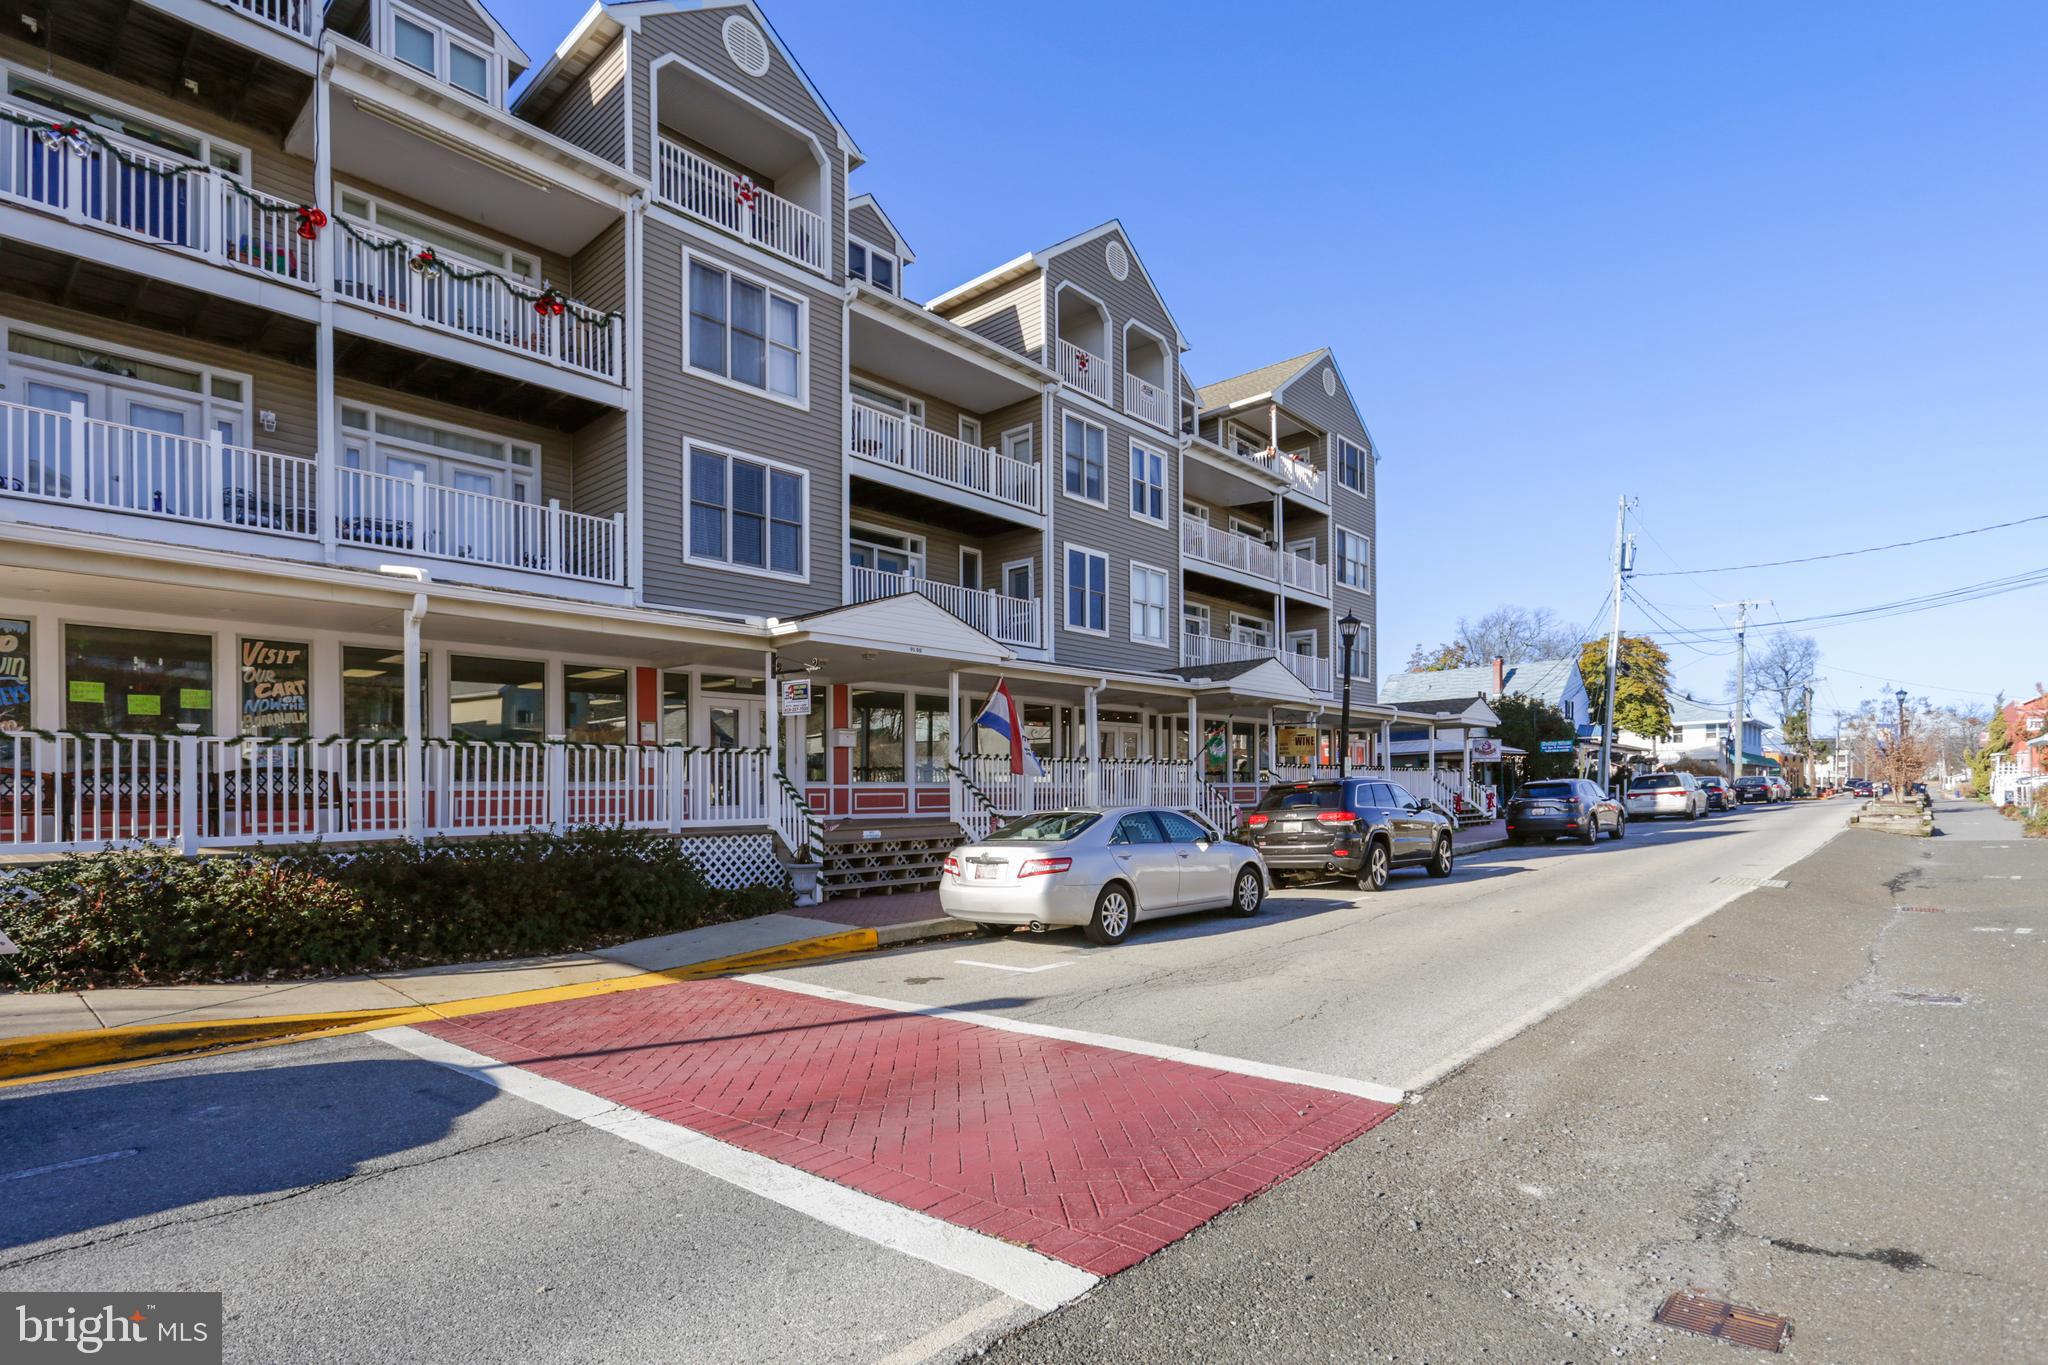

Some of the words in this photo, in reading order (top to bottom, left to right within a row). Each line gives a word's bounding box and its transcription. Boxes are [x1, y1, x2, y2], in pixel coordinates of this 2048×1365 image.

[243, 641, 301, 667] VISIT
[242, 666, 276, 683] OUR
[255, 680, 307, 698] CART
[244, 698, 282, 714] NOW
[1295, 736, 1315, 746] WINE
